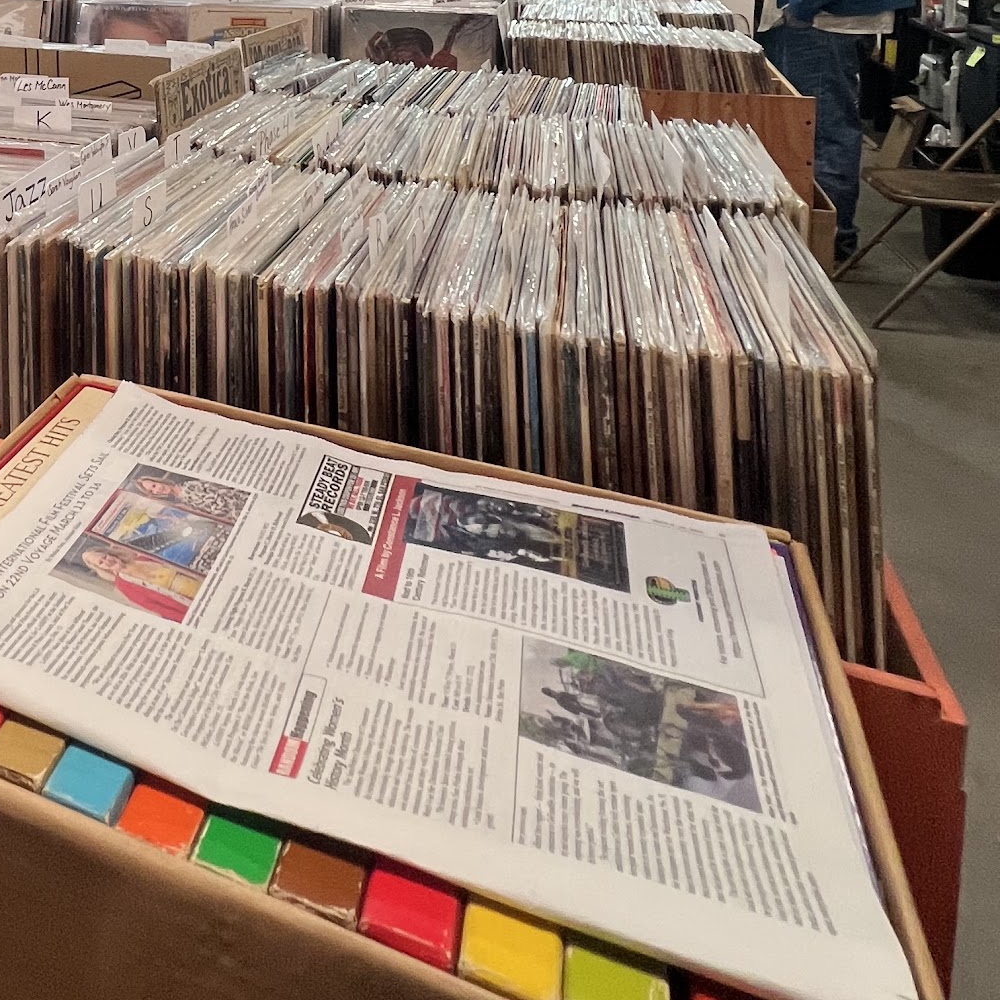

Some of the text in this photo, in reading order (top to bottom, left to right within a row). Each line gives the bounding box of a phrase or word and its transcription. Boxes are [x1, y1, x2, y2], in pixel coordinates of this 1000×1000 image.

[17, 79, 66, 92] Les McCann
[181, 61, 231, 121] Exotica
[37, 110, 51, 131] K
[143, 195, 154, 227] S
[39, 416, 81, 448] HITS
[81, 490, 95, 503] TO
[309, 457, 340, 510] STEADY BEAT
[321, 462, 349, 513] RECORDS
[39, 507, 61, 530] FILM
[53, 481, 82, 511] FESTIVAL
[76, 500, 87, 512] 13
[53, 508, 79, 537] MARCH
[383, 516, 399, 550] Constance
[22, 534, 58, 567] VOYAGE
[378, 558, 389, 574] Film
[381, 547, 392, 560] by
[6, 565, 30, 588] 22ND
[375, 571, 384, 580] A
[323, 696, 345, 737] Women's
[323, 731, 353, 791] History Month
